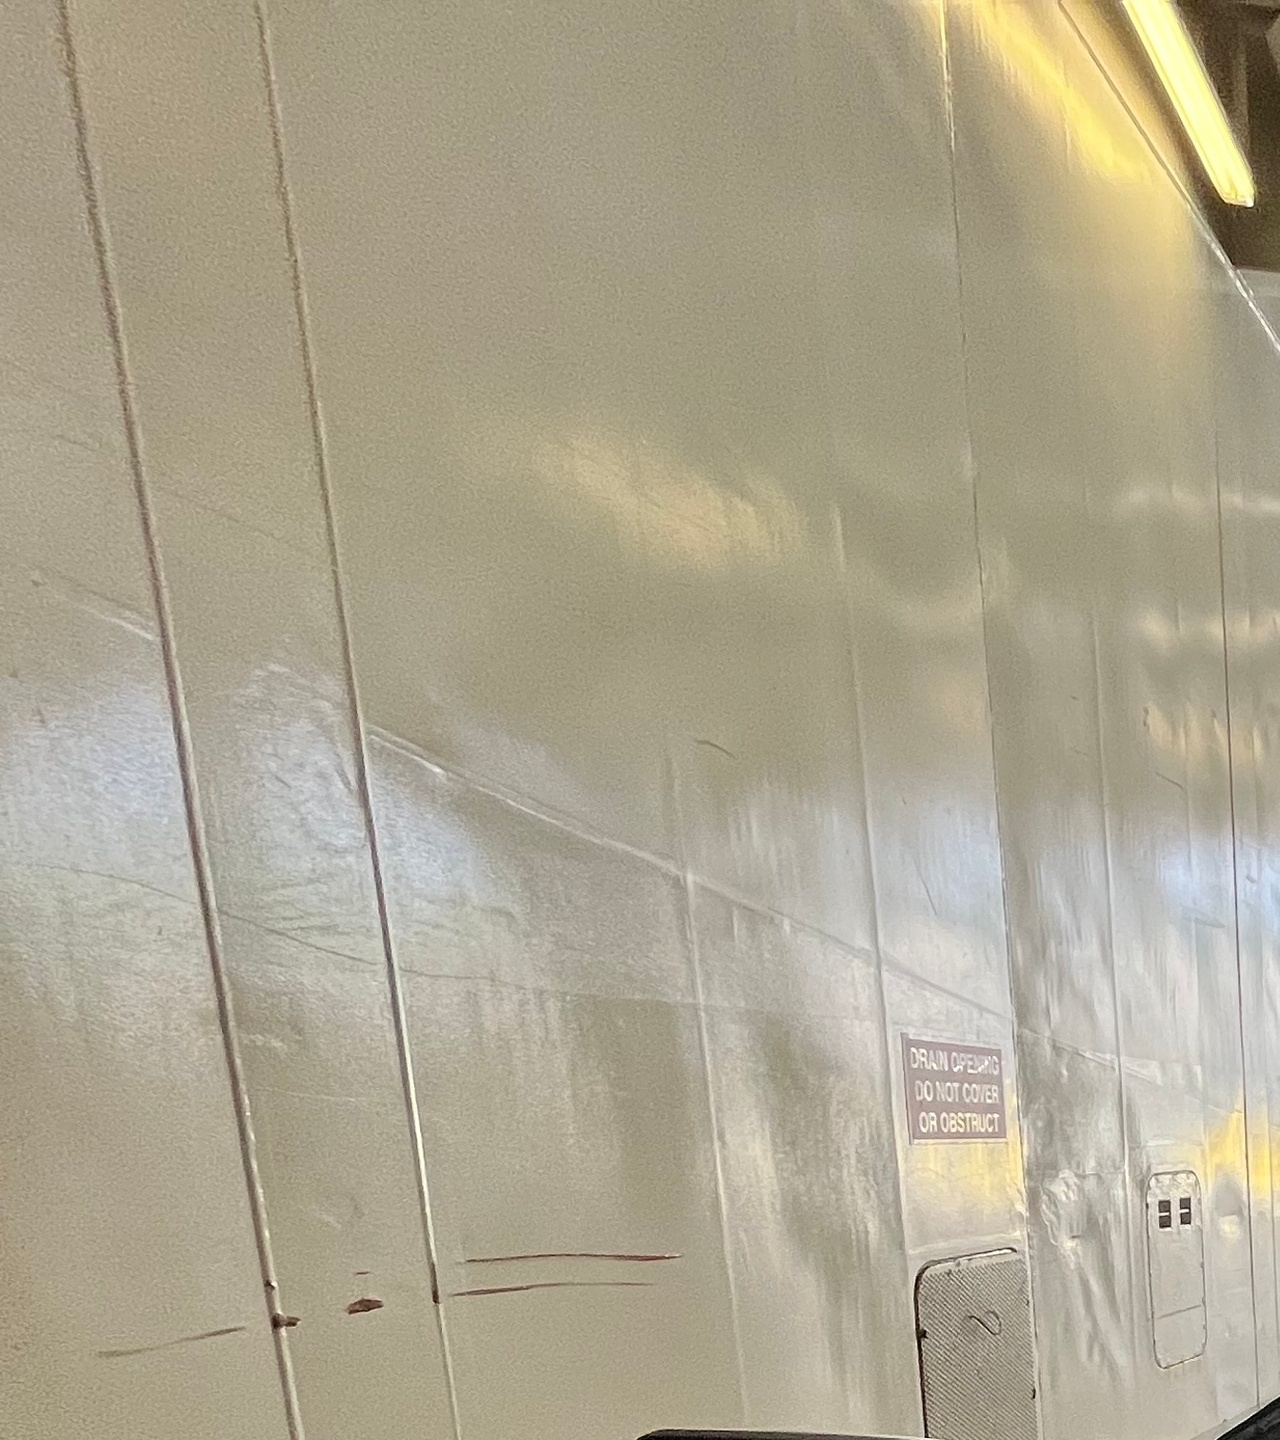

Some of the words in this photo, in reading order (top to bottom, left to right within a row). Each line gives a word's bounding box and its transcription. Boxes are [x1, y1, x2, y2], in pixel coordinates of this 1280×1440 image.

[909, 1046, 949, 1072] DRAIN
[914, 1080, 934, 1102] DO
[935, 1081, 961, 1103] NOT
[962, 1082, 1000, 1104] COVER
[918, 1111, 938, 1133] OR
[940, 1111, 1000, 1133] OBSTRUCT
